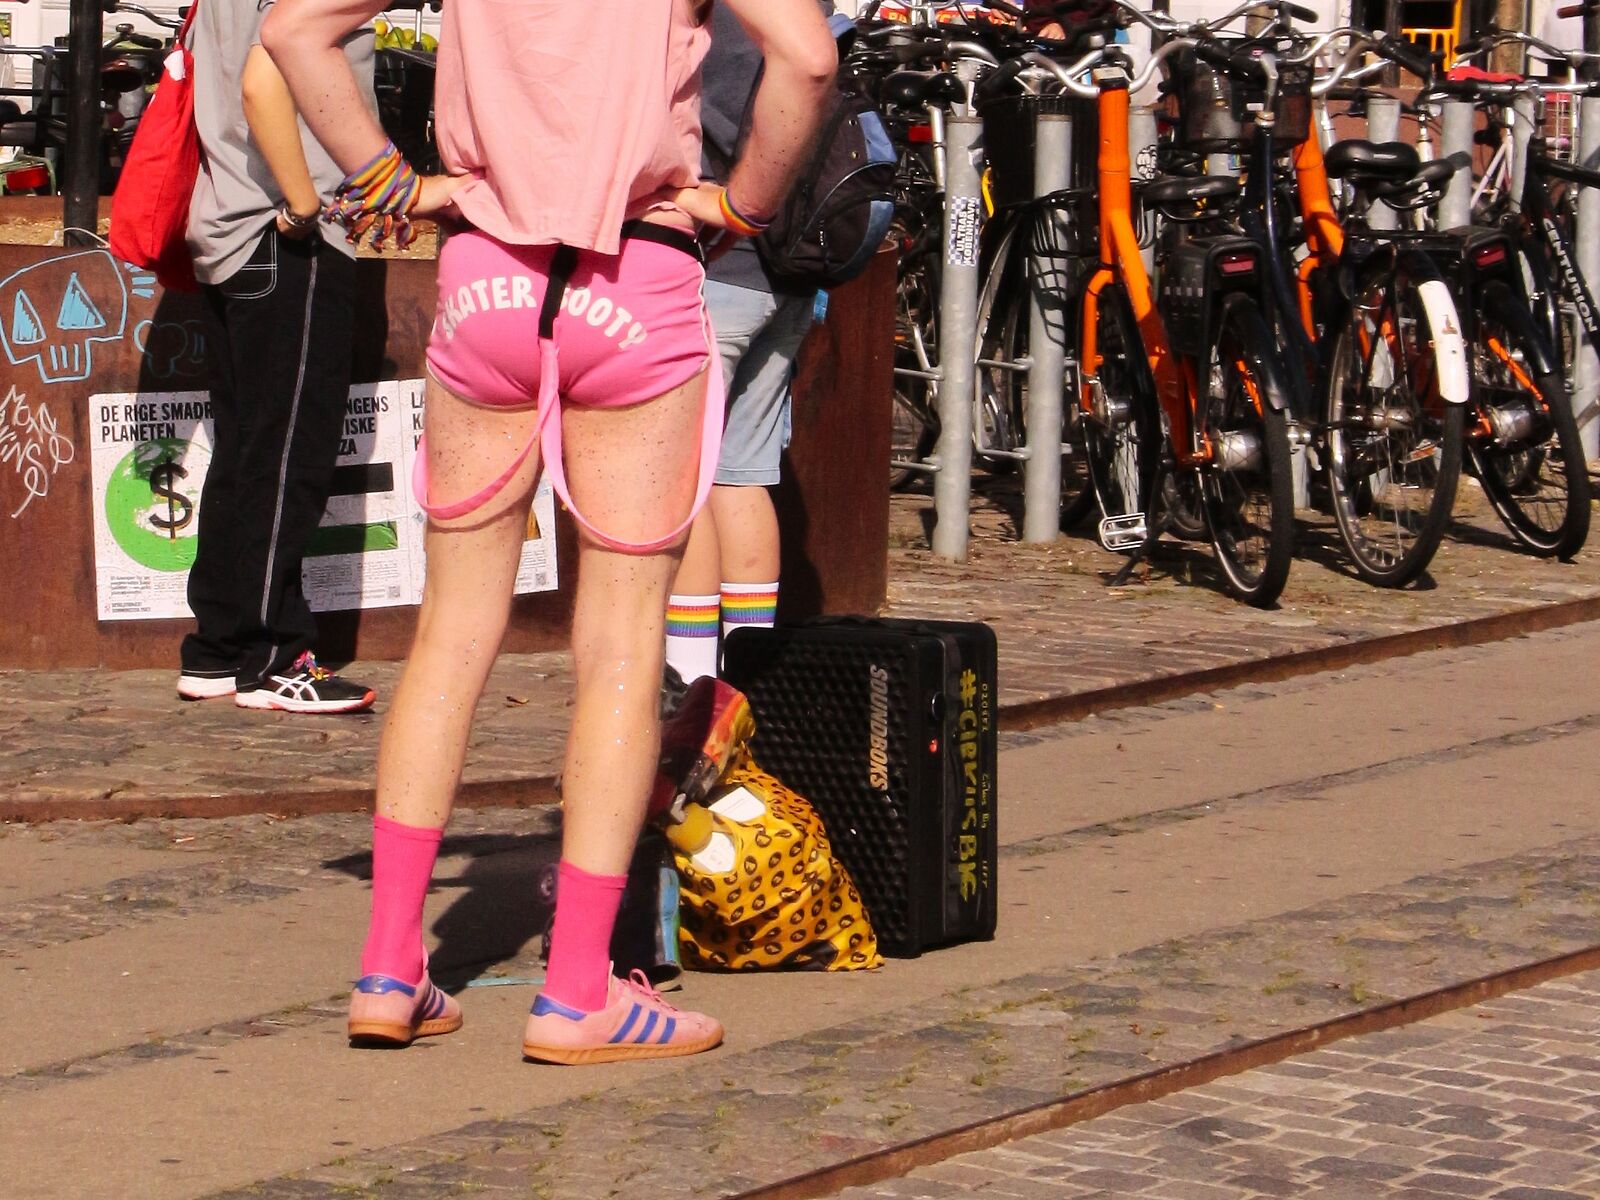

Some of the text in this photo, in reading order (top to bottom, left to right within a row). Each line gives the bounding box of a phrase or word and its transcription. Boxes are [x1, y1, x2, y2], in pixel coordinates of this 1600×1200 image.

[956, 210, 967, 252] ULTRAS
[1543, 218, 1598, 332] CENTURION
[442, 275, 537, 340] SKATER
[101, 405, 119, 423] DE
[124, 403, 157, 422] RIGE
[101, 422, 176, 443] PLANETEN
[870, 664, 888, 791] SOUNDBOKS
